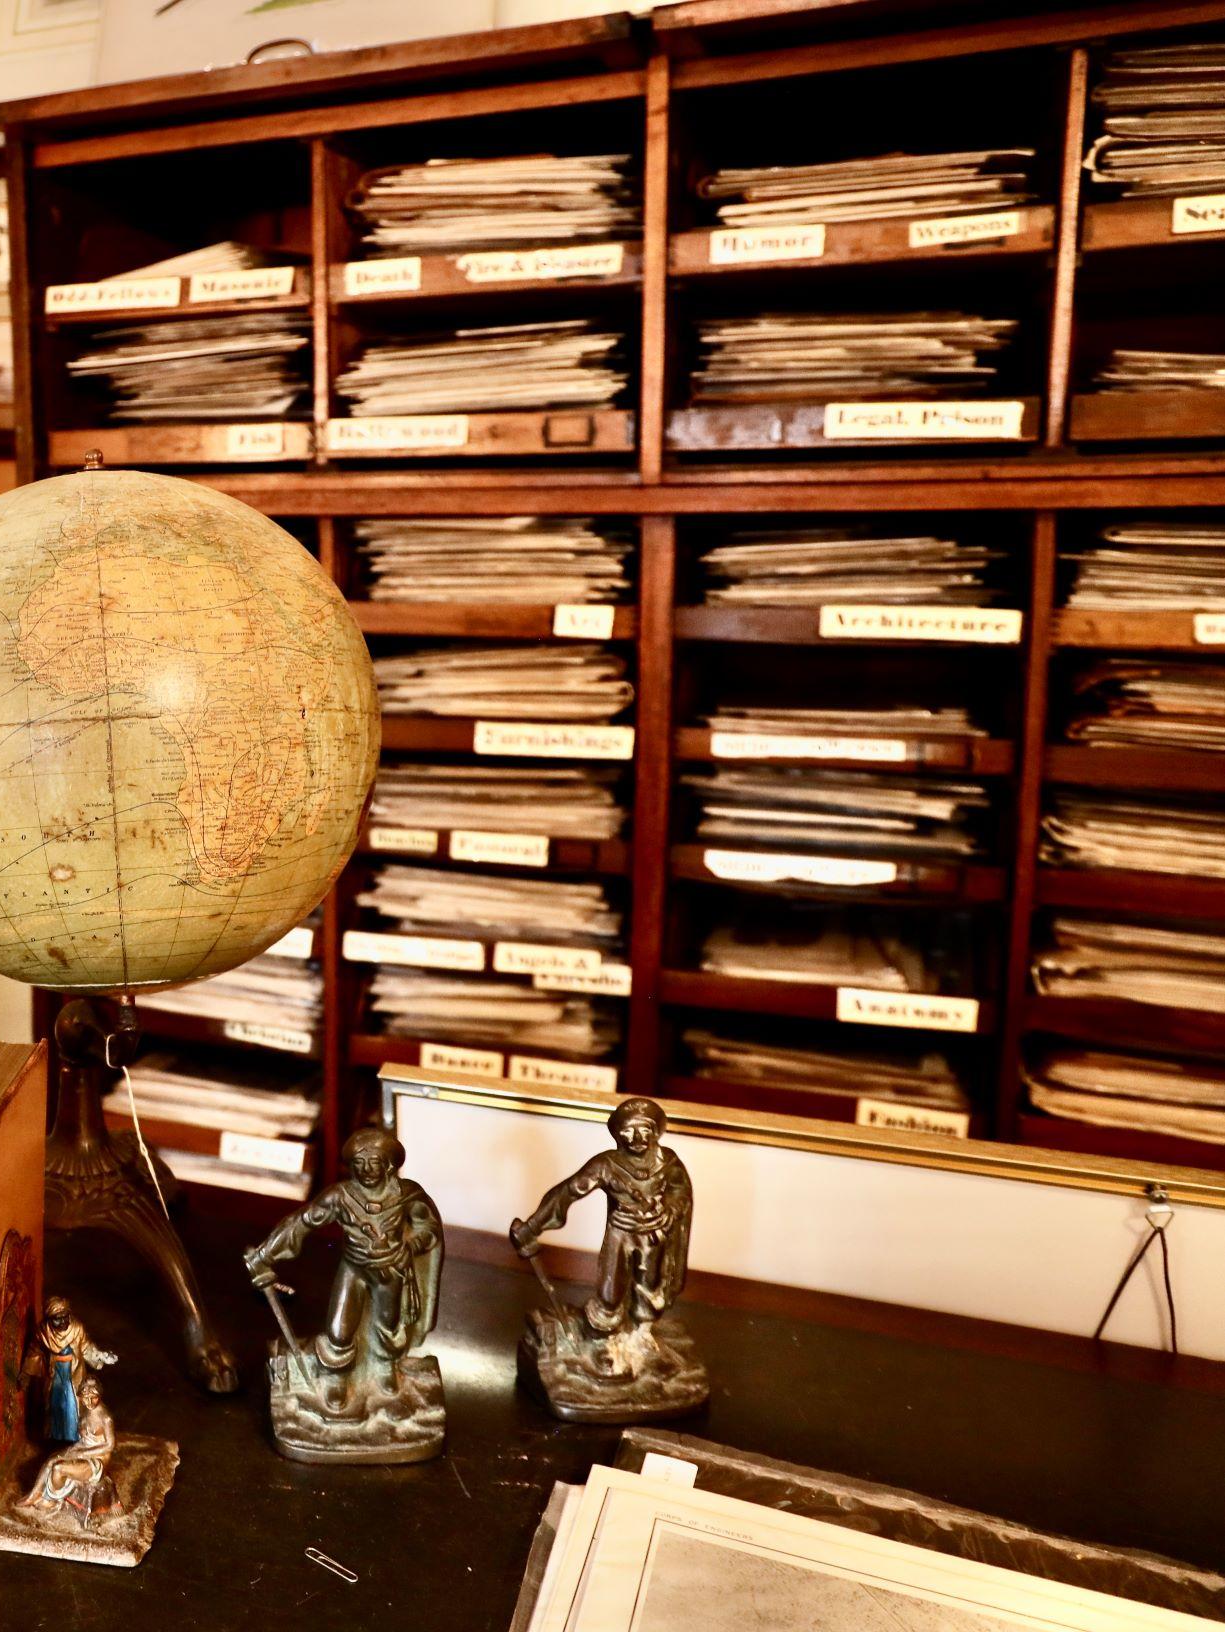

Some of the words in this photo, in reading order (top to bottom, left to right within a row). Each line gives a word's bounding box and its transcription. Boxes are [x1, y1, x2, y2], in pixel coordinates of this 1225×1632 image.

[917, 218, 1012, 239] Weapons
[722, 235, 810, 251] Humor
[356, 268, 413, 284] Death
[97, 286, 171, 300] Fellows
[202, 278, 281, 293] Masonic
[836, 613, 1007, 632] Architecture
[30, 932, 120, 943] OCEAN
[655, 1511, 682, 1523] CORPS
[688, 1519, 698, 1527] OF
[704, 1524, 755, 1541] ENGINEERS
